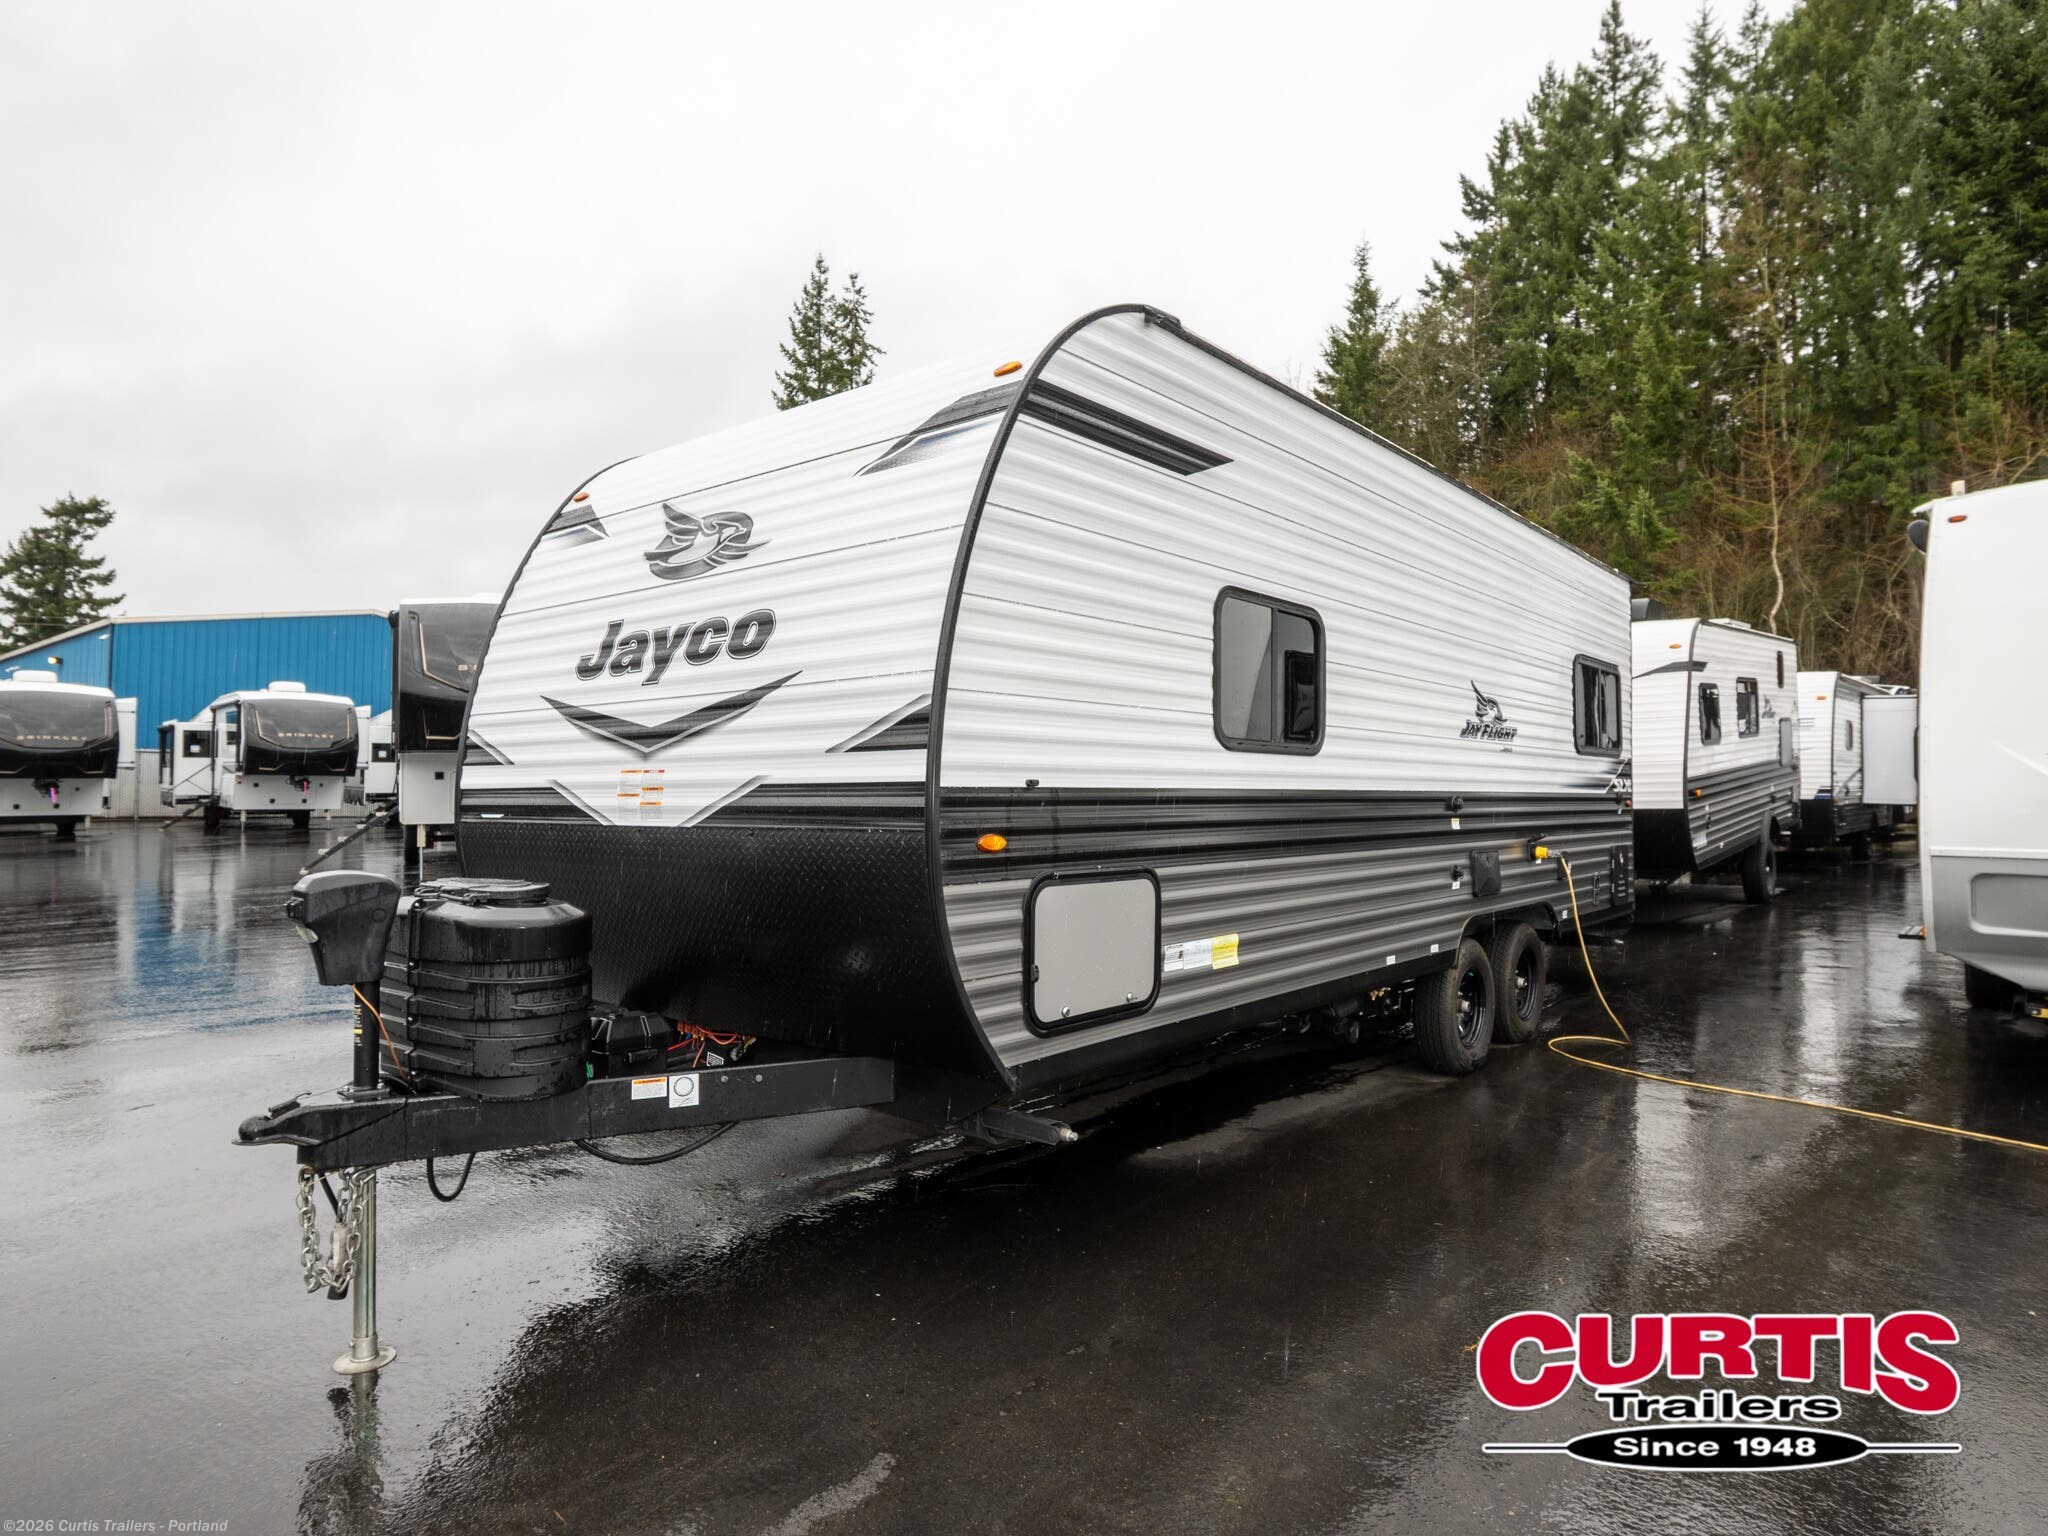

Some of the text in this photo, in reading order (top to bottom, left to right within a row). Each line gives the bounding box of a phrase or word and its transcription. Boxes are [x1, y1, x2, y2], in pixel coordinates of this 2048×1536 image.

[575, 609, 776, 686] Jayco
[1460, 719, 1518, 742] JAY FLIGHT
